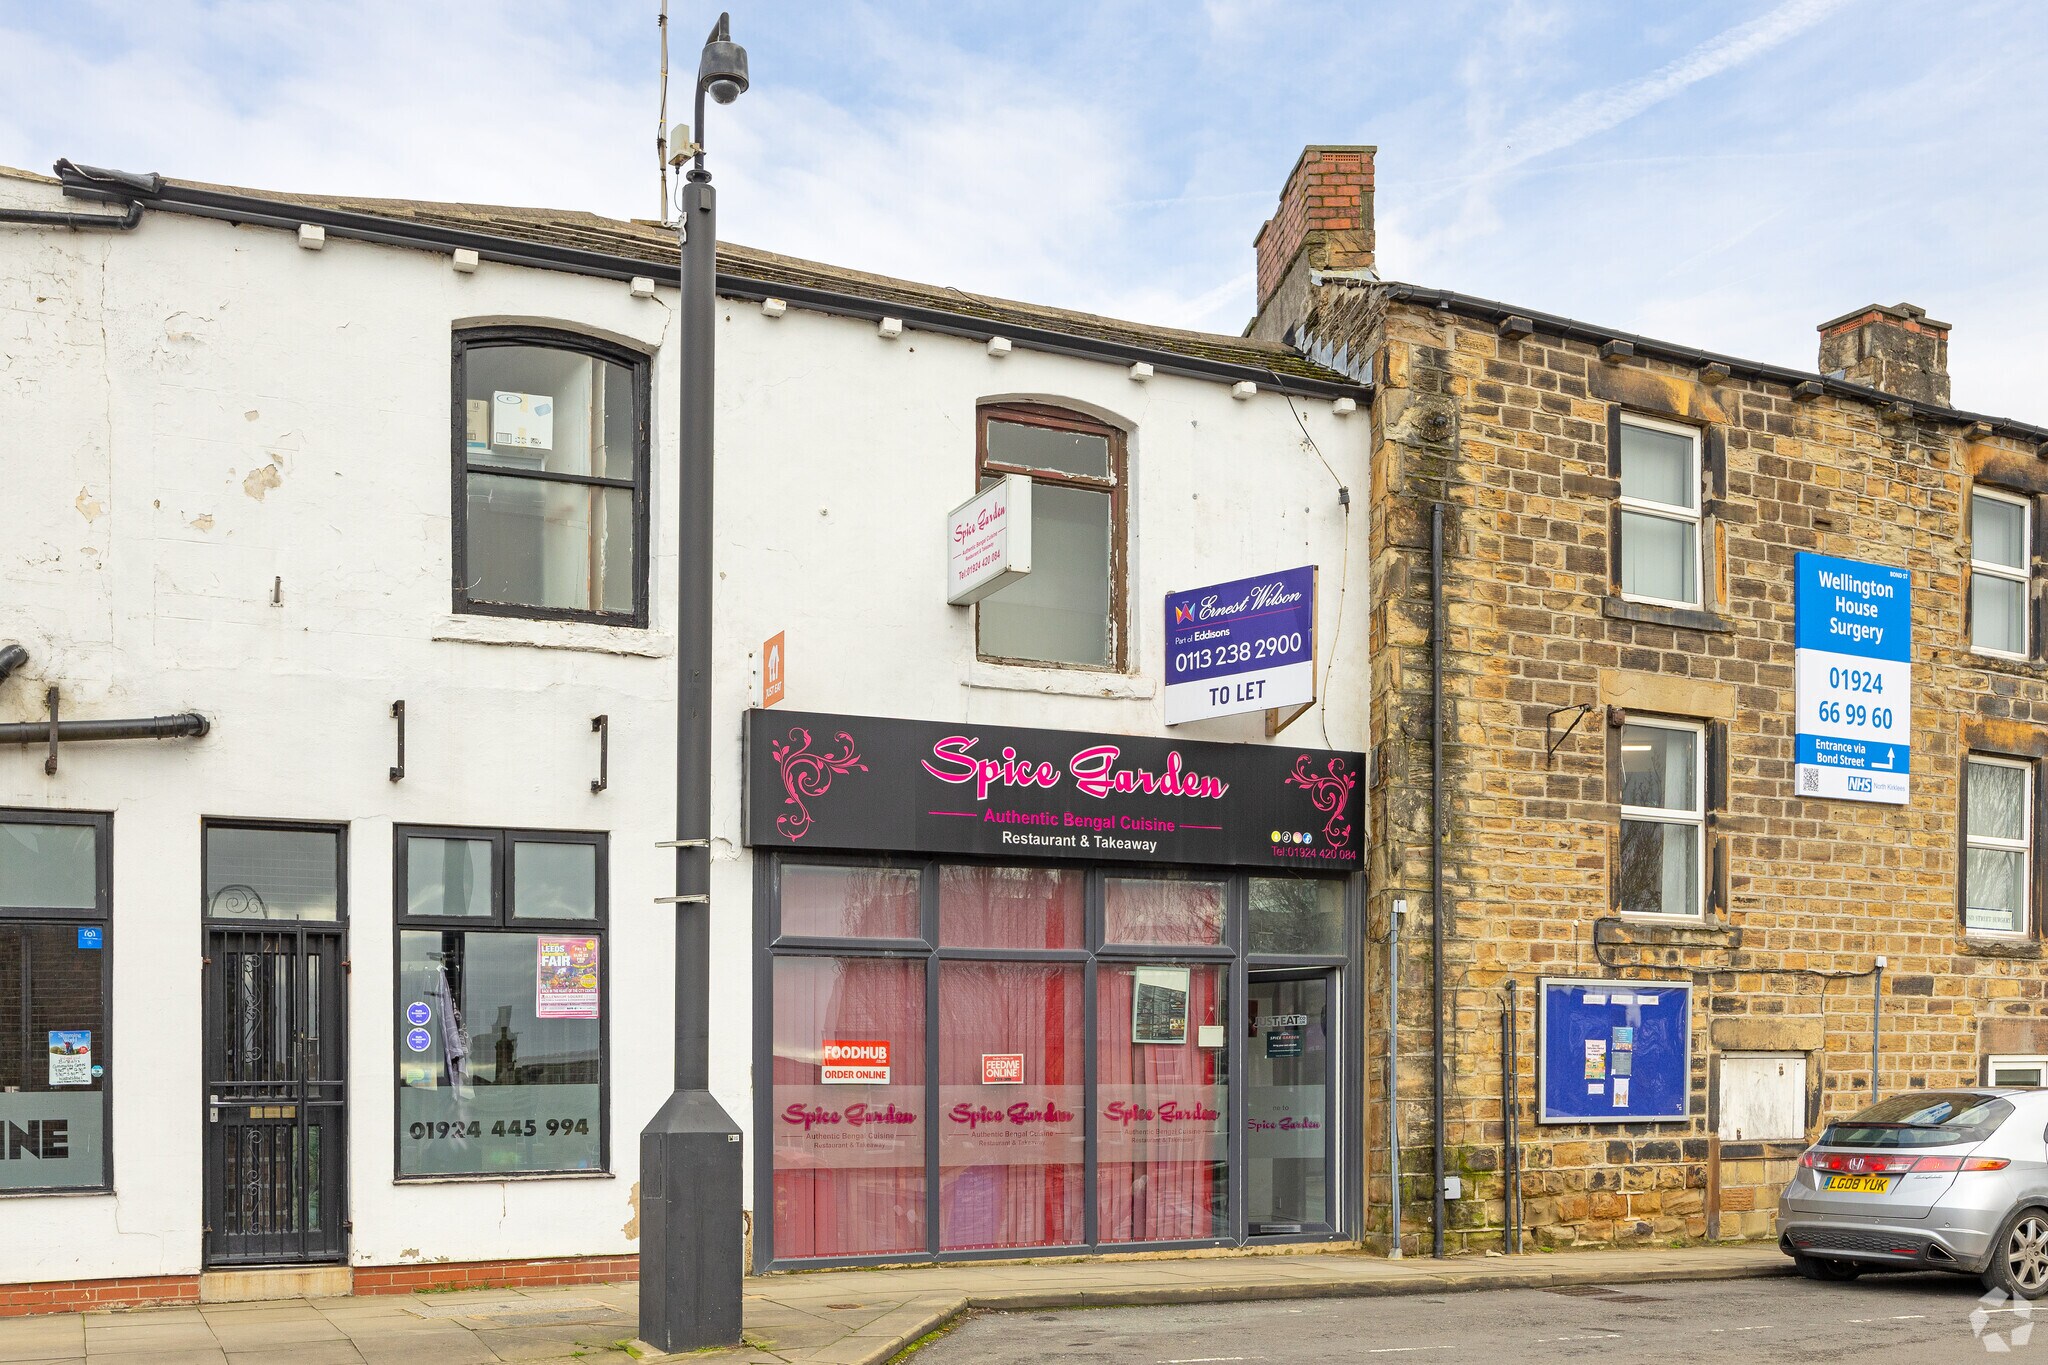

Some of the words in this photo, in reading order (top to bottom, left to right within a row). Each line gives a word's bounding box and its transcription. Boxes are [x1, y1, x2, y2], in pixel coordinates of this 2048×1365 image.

[954, 523, 976, 545] Spice
[978, 502, 1006, 530] Garden
[1818, 570, 1894, 599] Wellington
[1199, 594, 1249, 620] Ernest
[1250, 582, 1302, 611] Wilson
[1836, 596, 1878, 618] House
[1176, 636, 1186, 645] Part
[1187, 634, 1193, 642] of
[1194, 628, 1230, 642] Eddisons
[1830, 617, 1884, 645] Surgery
[1175, 648, 1212, 672] 0113
[1215, 642, 1251, 666] 238
[1255, 632, 1301, 659] 2900
[1830, 667, 1883, 694] 01924
[1209, 686, 1230, 706] TO
[1237, 680, 1266, 702] LET
[1819, 700, 1840, 723] 66
[1845, 704, 1866, 726] 99
[1872, 708, 1892, 729] 60
[1816, 739, 1852, 753] Entrance
[1854, 744, 1866, 754] via
[920, 736, 1060, 800] Spice
[1070, 745, 1229, 799] Garden
[1817, 752, 1838, 764] Bond
[1840, 755, 1865, 767] Street
[1848, 776, 1871, 792] NHS
[984, 808, 1059, 826] Authentic
[1063, 811, 1116, 832] Bengal
[1119, 815, 1175, 832] Cuisine
[1002, 831, 1076, 846] Restaurant
[1080, 834, 1090, 847] &
[1093, 835, 1157, 853] Takeaway
[1271, 846, 1316, 858] Tel:01924
[1319, 849, 1336, 859] 420
[1340, 850, 1356, 860] 084
[542, 956, 570, 966] FAIR
[1254, 1016, 1279, 1027] JUST
[1280, 1016, 1299, 1025] EAT
[825, 1046, 887, 1060] FOODHUB
[825, 1070, 854, 1078] ORDER
[856, 1070, 886, 1079] ONLINE
[986, 1060, 1020, 1069] FEEDME
[986, 1069, 1017, 1077] ONLINE
[781, 1103, 842, 1131] Spice
[844, 1102, 917, 1127] Garden
[948, 1102, 1004, 1129] Spice
[1007, 1102, 1074, 1125] Garden
[1103, 1101, 1155, 1126] Spice
[1158, 1102, 1220, 1123] Garden
[1248, 1119, 1276, 1132] Spice
[1279, 1116, 1320, 1130] Garden
[410, 1120, 482, 1140] 01924
[491, 1120, 537, 1138] 445
[546, 1119, 589, 1136] 994
[1830, 1178, 1861, 1189] LG08
[1863, 1179, 1887, 1191] YUK
